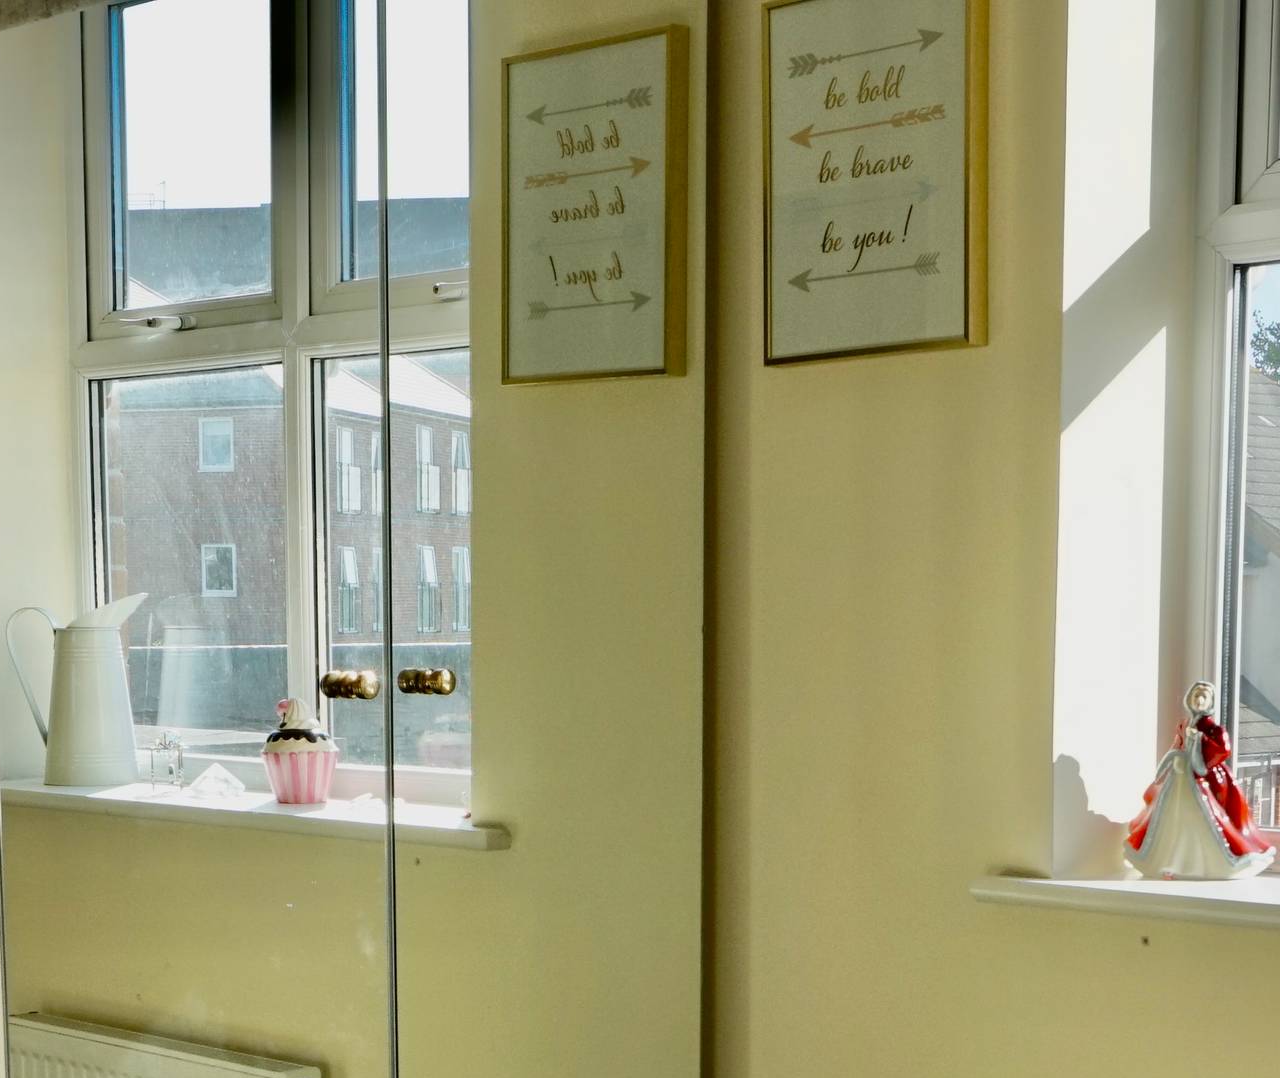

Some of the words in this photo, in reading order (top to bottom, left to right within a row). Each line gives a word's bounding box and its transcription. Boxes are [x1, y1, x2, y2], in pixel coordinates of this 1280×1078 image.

[823, 76, 847, 111] be
[856, 64, 906, 105] bold
[818, 150, 842, 184] be
[850, 145, 914, 180] brave
[820, 219, 843, 254] be
